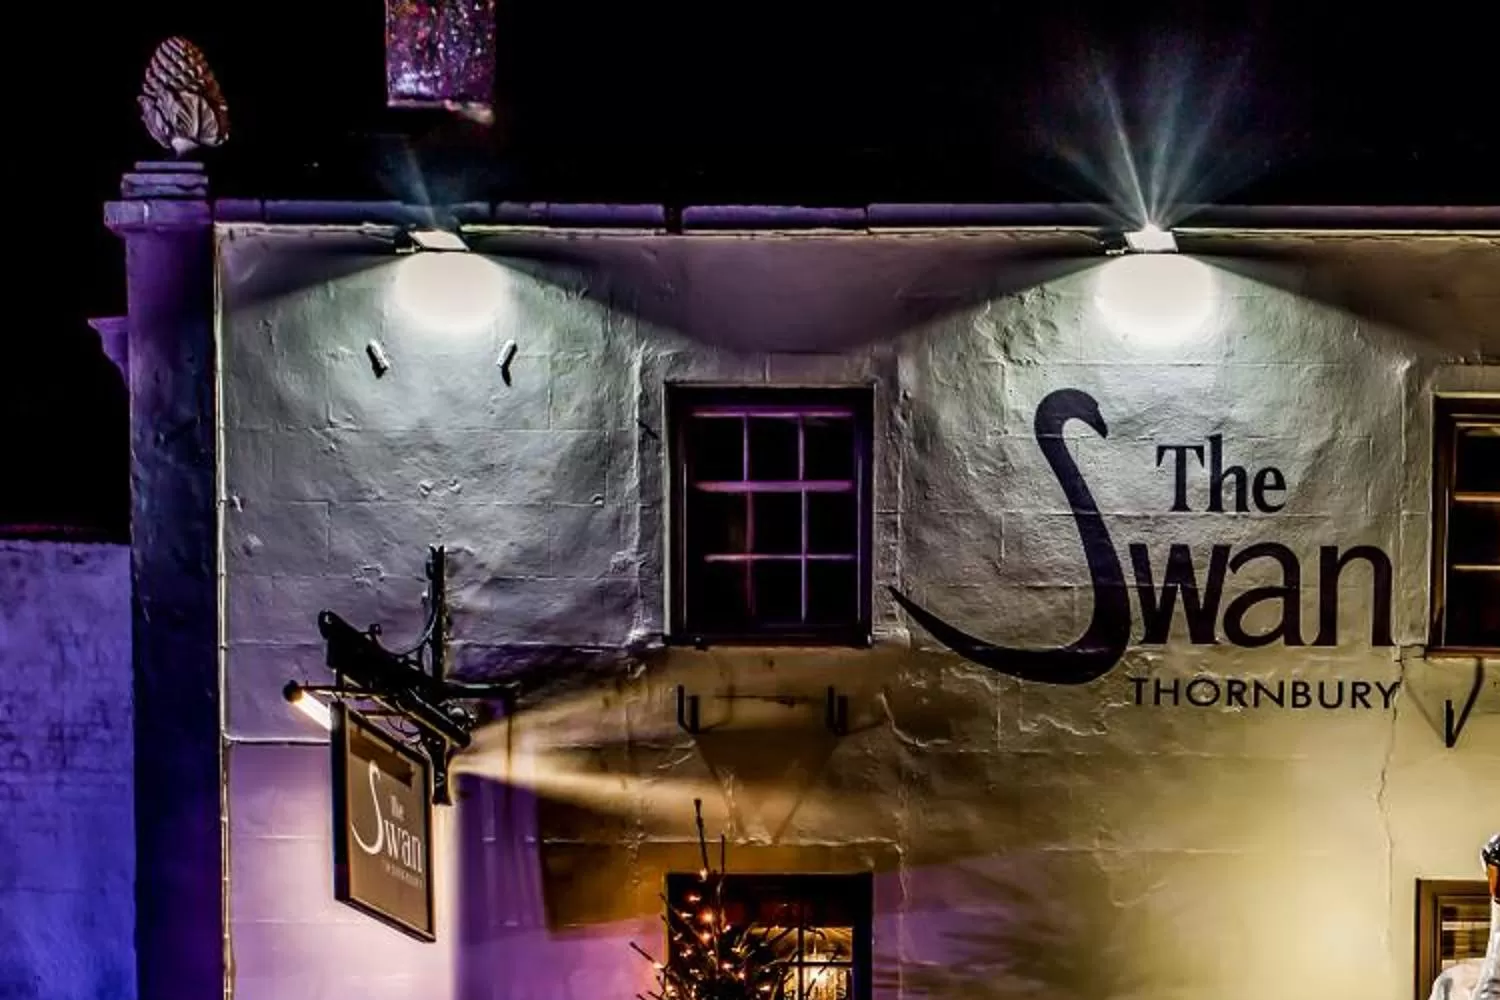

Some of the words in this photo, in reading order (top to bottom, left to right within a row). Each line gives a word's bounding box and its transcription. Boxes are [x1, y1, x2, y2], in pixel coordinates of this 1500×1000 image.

[1155, 433, 1287, 513] The
[887, 387, 1395, 685] Swan
[1129, 677, 1400, 709] THORNBURY
[350, 759, 423, 874] Swan
